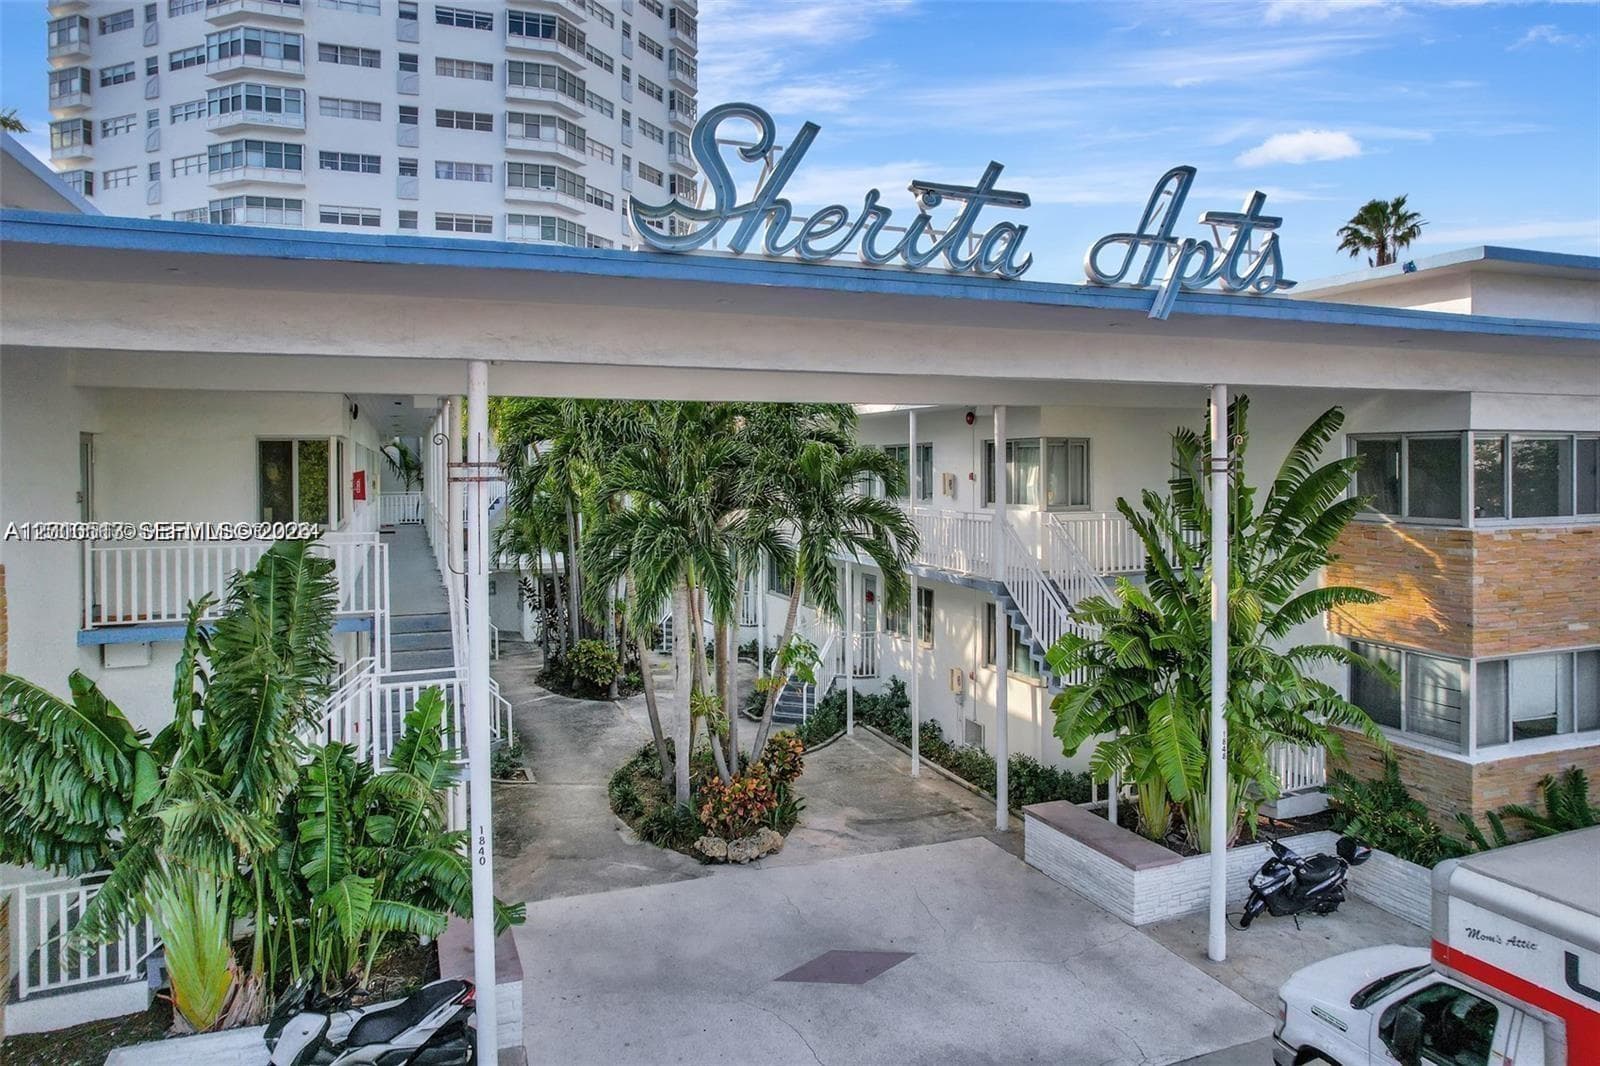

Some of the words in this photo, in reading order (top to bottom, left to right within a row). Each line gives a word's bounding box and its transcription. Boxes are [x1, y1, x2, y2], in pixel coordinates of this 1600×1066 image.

[629, 102, 1032, 280] Sherita
[1085, 164, 1296, 320] Apts
[478, 825, 486, 866] 1840
[1465, 927, 1502, 945] Mom's
[1506, 935, 1538, 951] Attic
